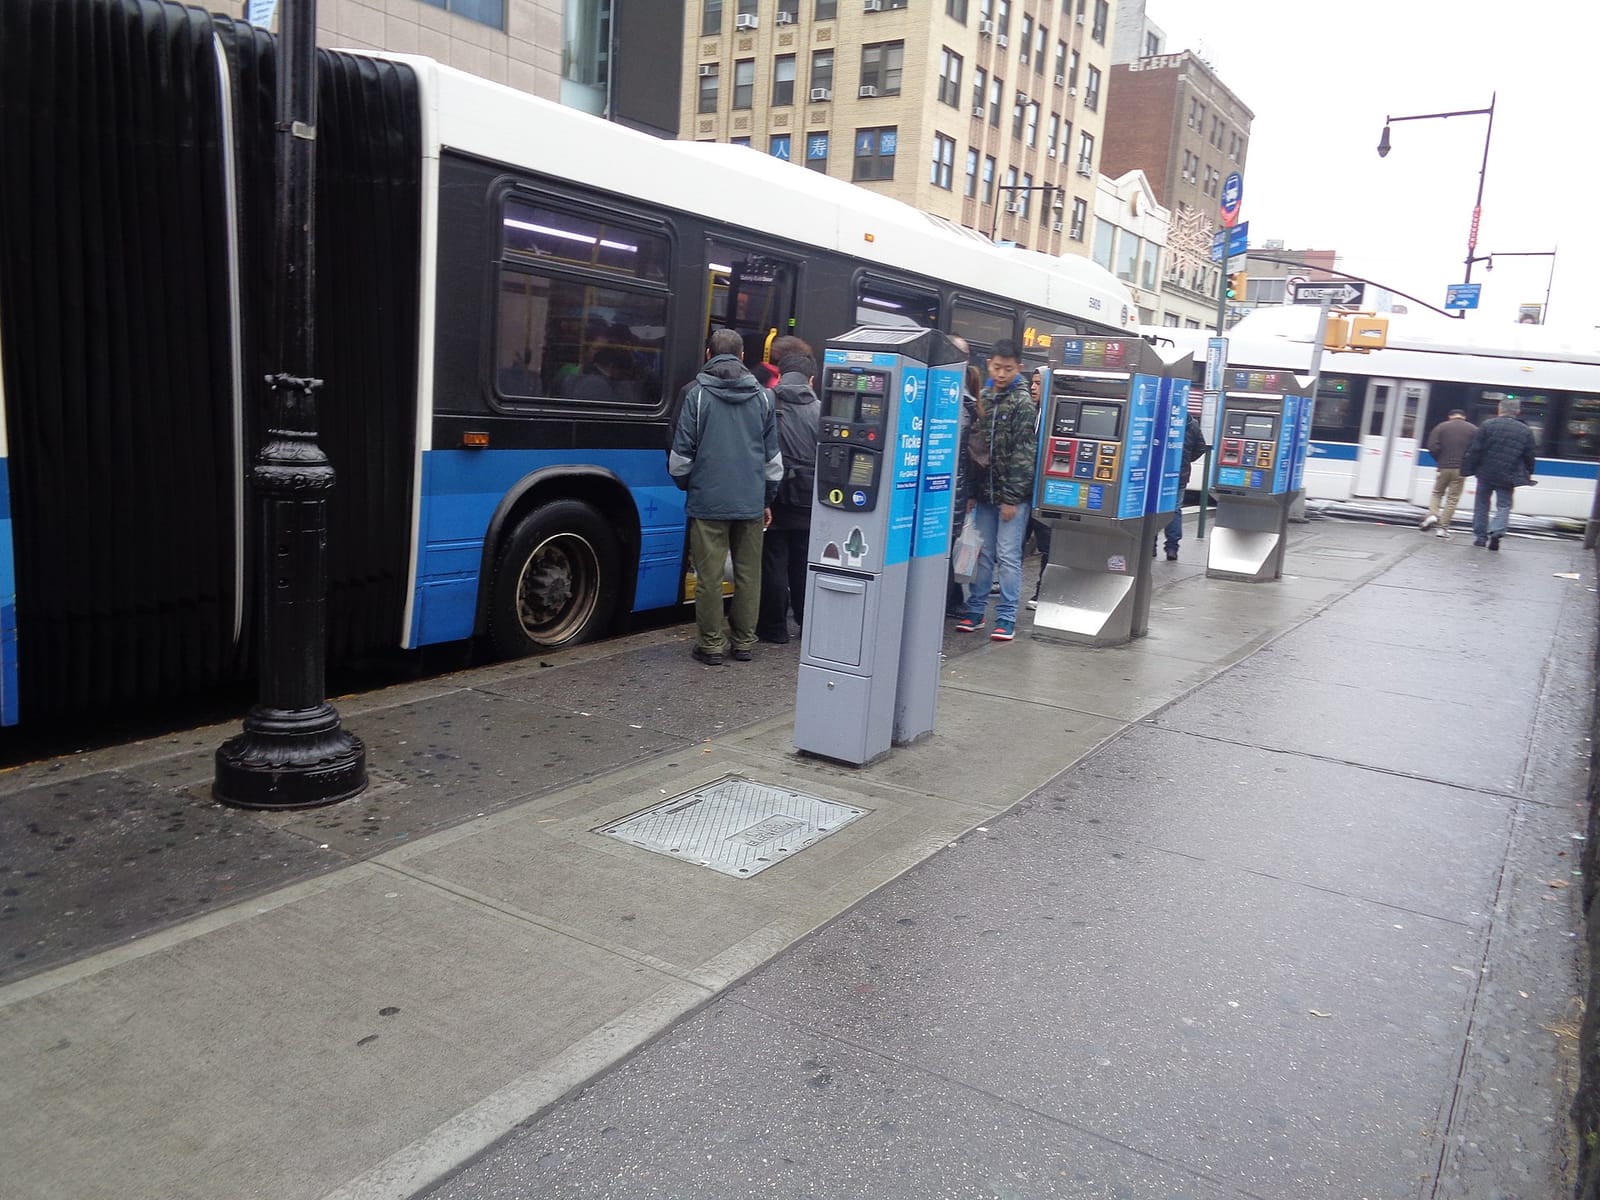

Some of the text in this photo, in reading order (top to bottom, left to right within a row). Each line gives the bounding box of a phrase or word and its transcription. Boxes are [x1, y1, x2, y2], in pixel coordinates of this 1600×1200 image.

[775, 141, 789, 157] 人
[1304, 289, 1353, 299] ONE WAY
[911, 416, 923, 430] Ge
[901, 434, 921, 448] Ticke
[904, 452, 919, 466] Her
